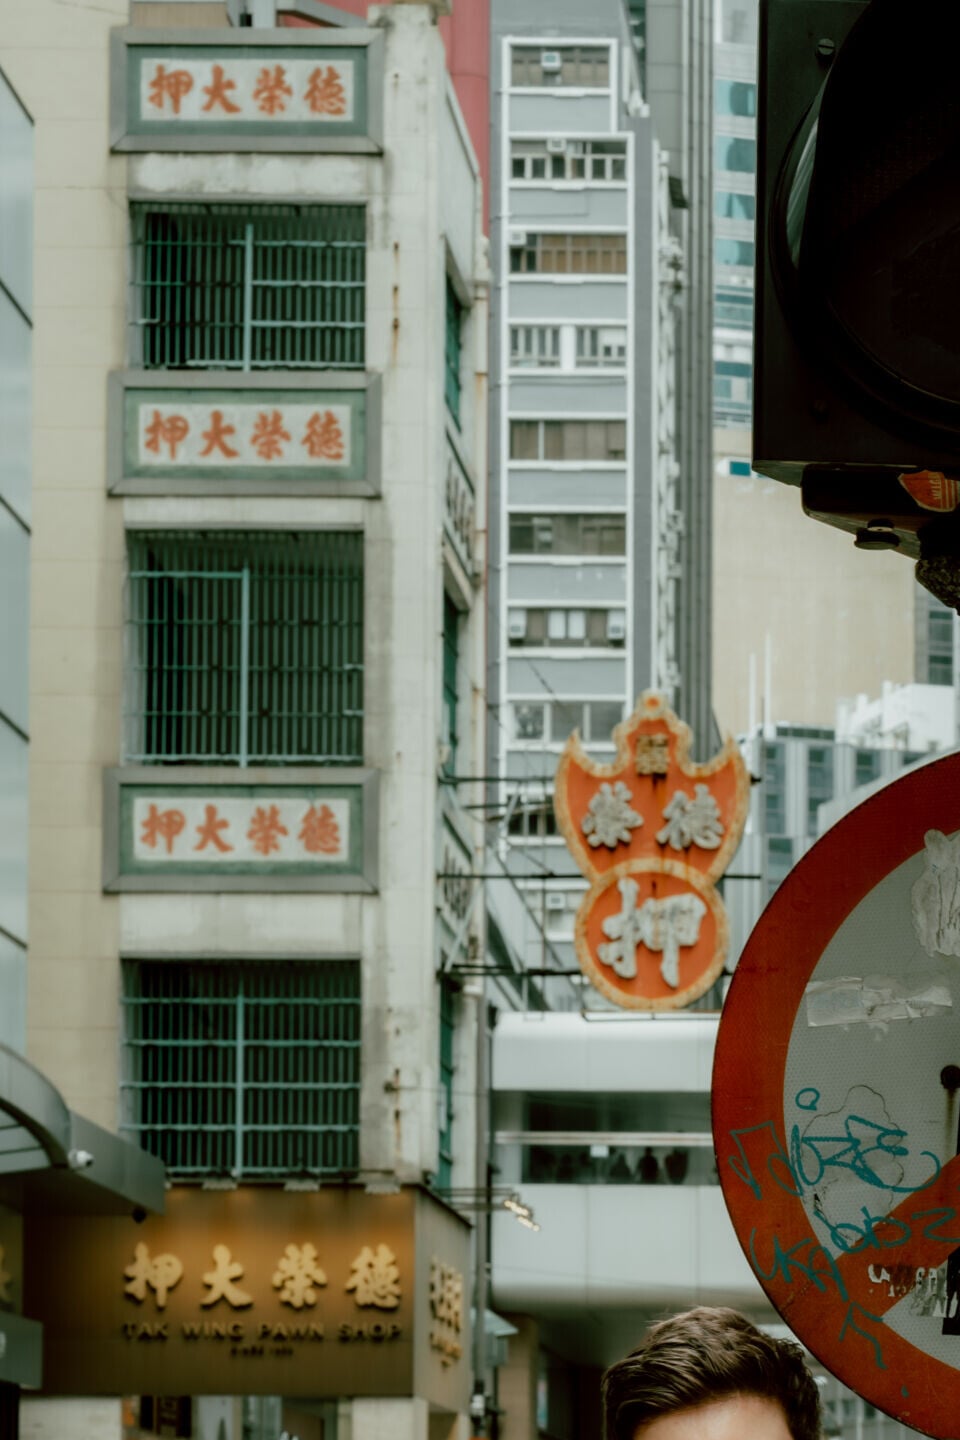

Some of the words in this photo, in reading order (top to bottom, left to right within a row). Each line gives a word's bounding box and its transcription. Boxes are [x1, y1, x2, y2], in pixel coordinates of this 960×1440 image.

[597, 877, 707, 989] 押
[122, 1320, 169, 1340] TAK
[182, 1320, 245, 1340] WING
[256, 1320, 325, 1340] PAWN
[337, 1320, 402, 1341] SHOP
